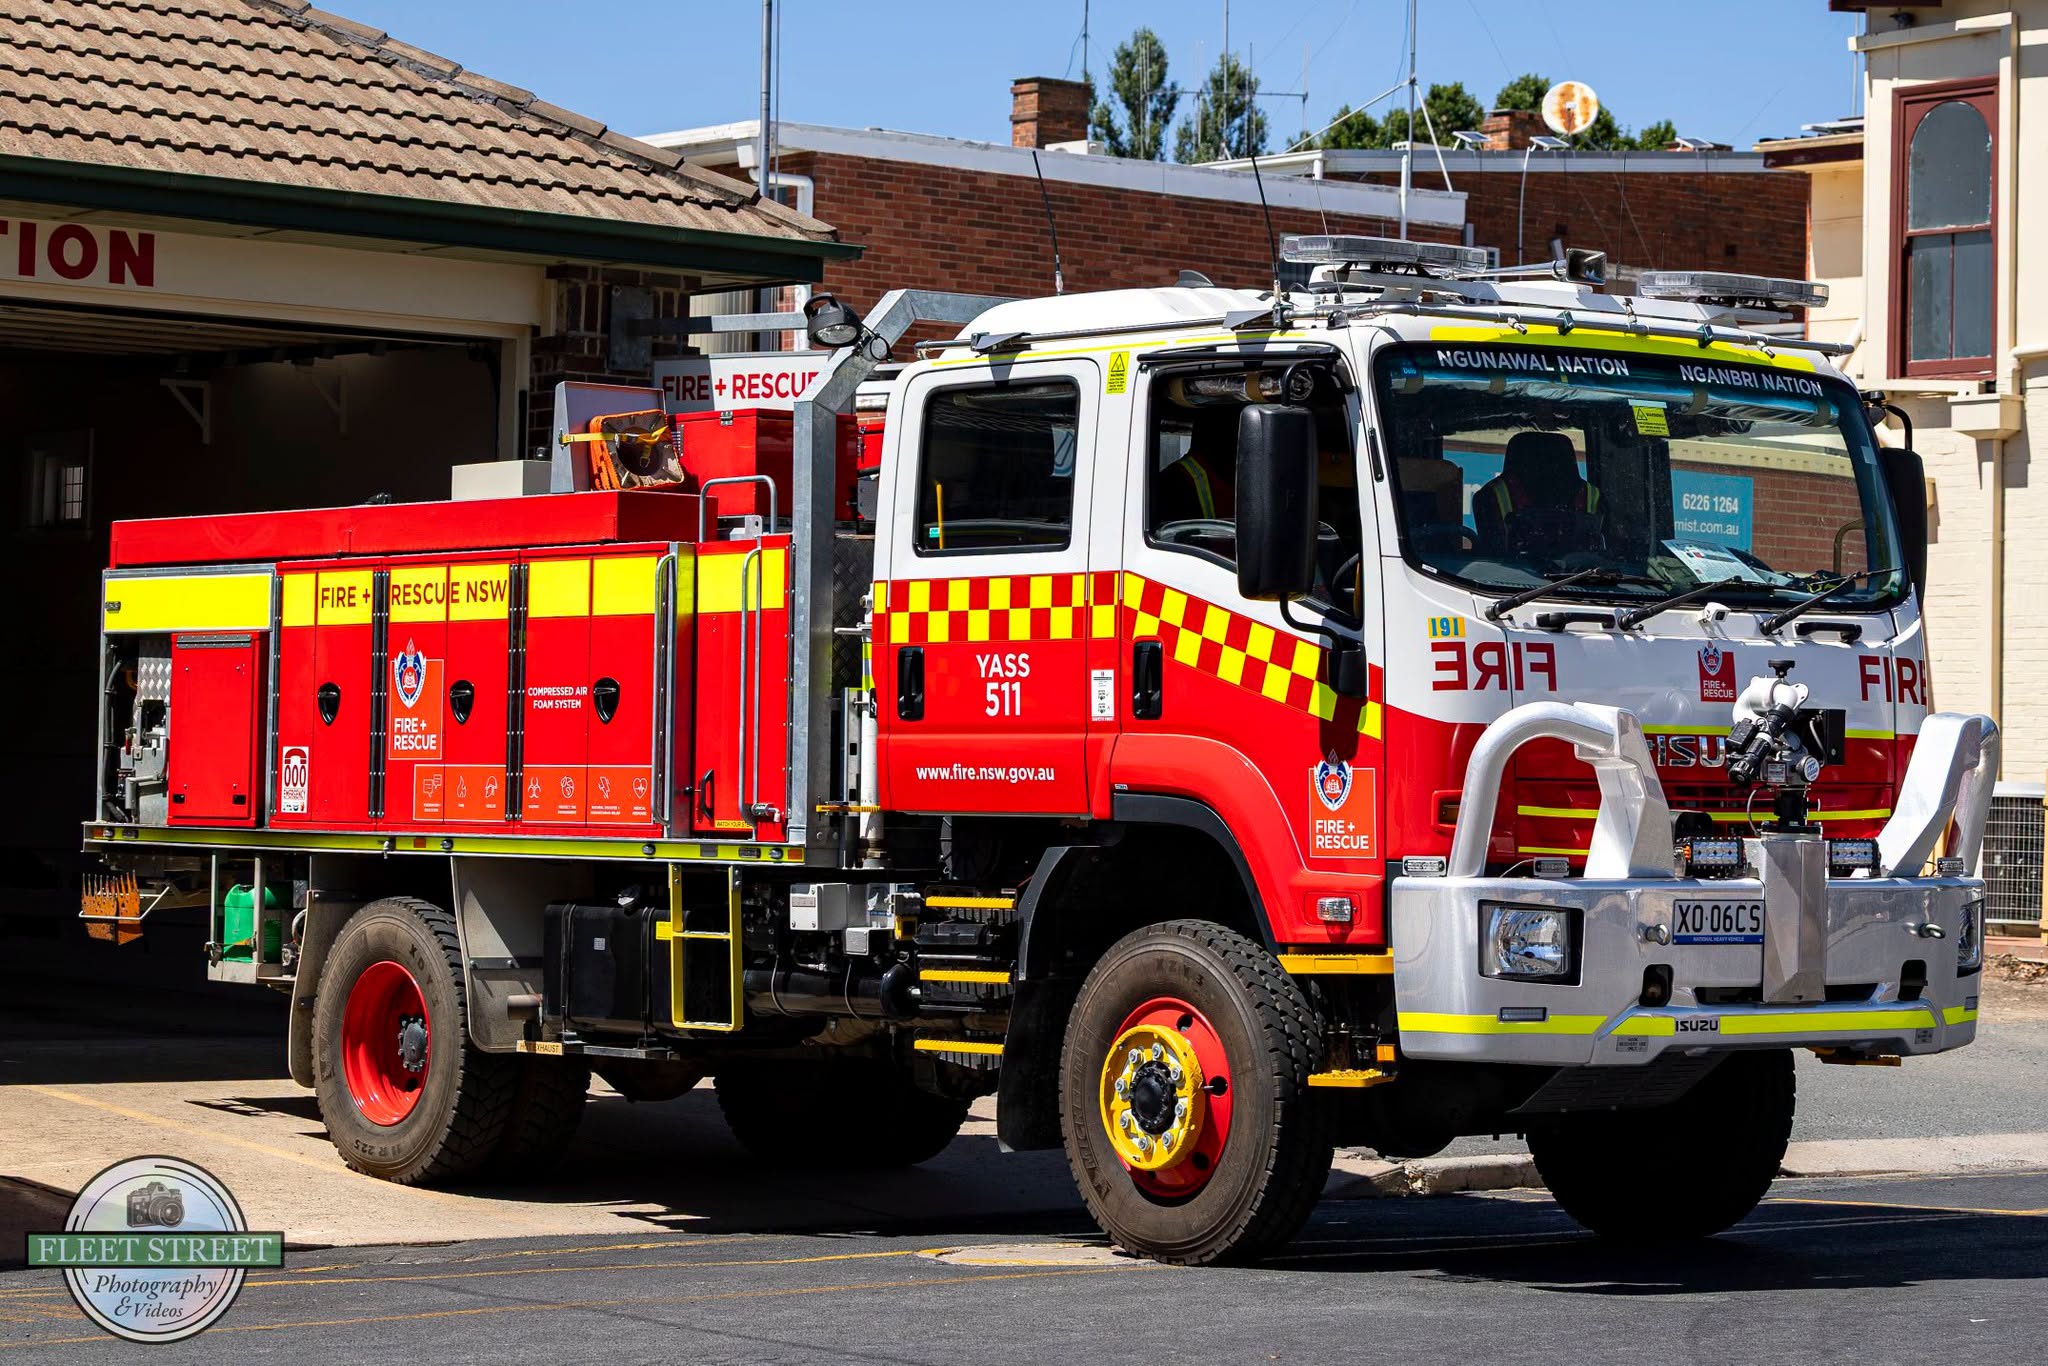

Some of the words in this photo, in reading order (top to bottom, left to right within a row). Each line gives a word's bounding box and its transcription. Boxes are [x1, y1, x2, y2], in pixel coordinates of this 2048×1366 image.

[1436, 350, 1554, 372] NGUNAWAL
[1557, 355, 1630, 376] NATION
[662, 374, 710, 401] FIRE
[1679, 364, 1759, 389] NGANBRI
[1761, 373, 1824, 397] NATION
[1682, 493, 1710, 511] 6226
[1713, 495, 1739, 514] 1264
[321, 586, 357, 608] FIRE
[391, 582, 460, 606] RESCUE
[466, 579, 507, 603] NSW
[1431, 617, 1459, 637] 191
[975, 653, 1031, 678] YASS
[528, 687, 574, 696] COMPRESSED
[575, 686, 588, 696] AIR
[1702, 680, 1720, 689] FIRE
[1703, 689, 1734, 698] RESCUE
[533, 700, 553, 709] FOAM
[554, 699, 582, 709] SYSTEM
[985, 681, 1021, 717] 511
[394, 718, 418, 733] FIRE
[393, 734, 437, 751] RESCUE
[1657, 735, 1726, 768] ISU
[284, 764, 307, 788] 000
[916, 763, 1055, 783] www.fire.nsw.gov.au
[1315, 820, 1345, 834] FIRE
[1315, 835, 1369, 849] RESCUE
[1675, 1019, 1718, 1032] ISUZU
